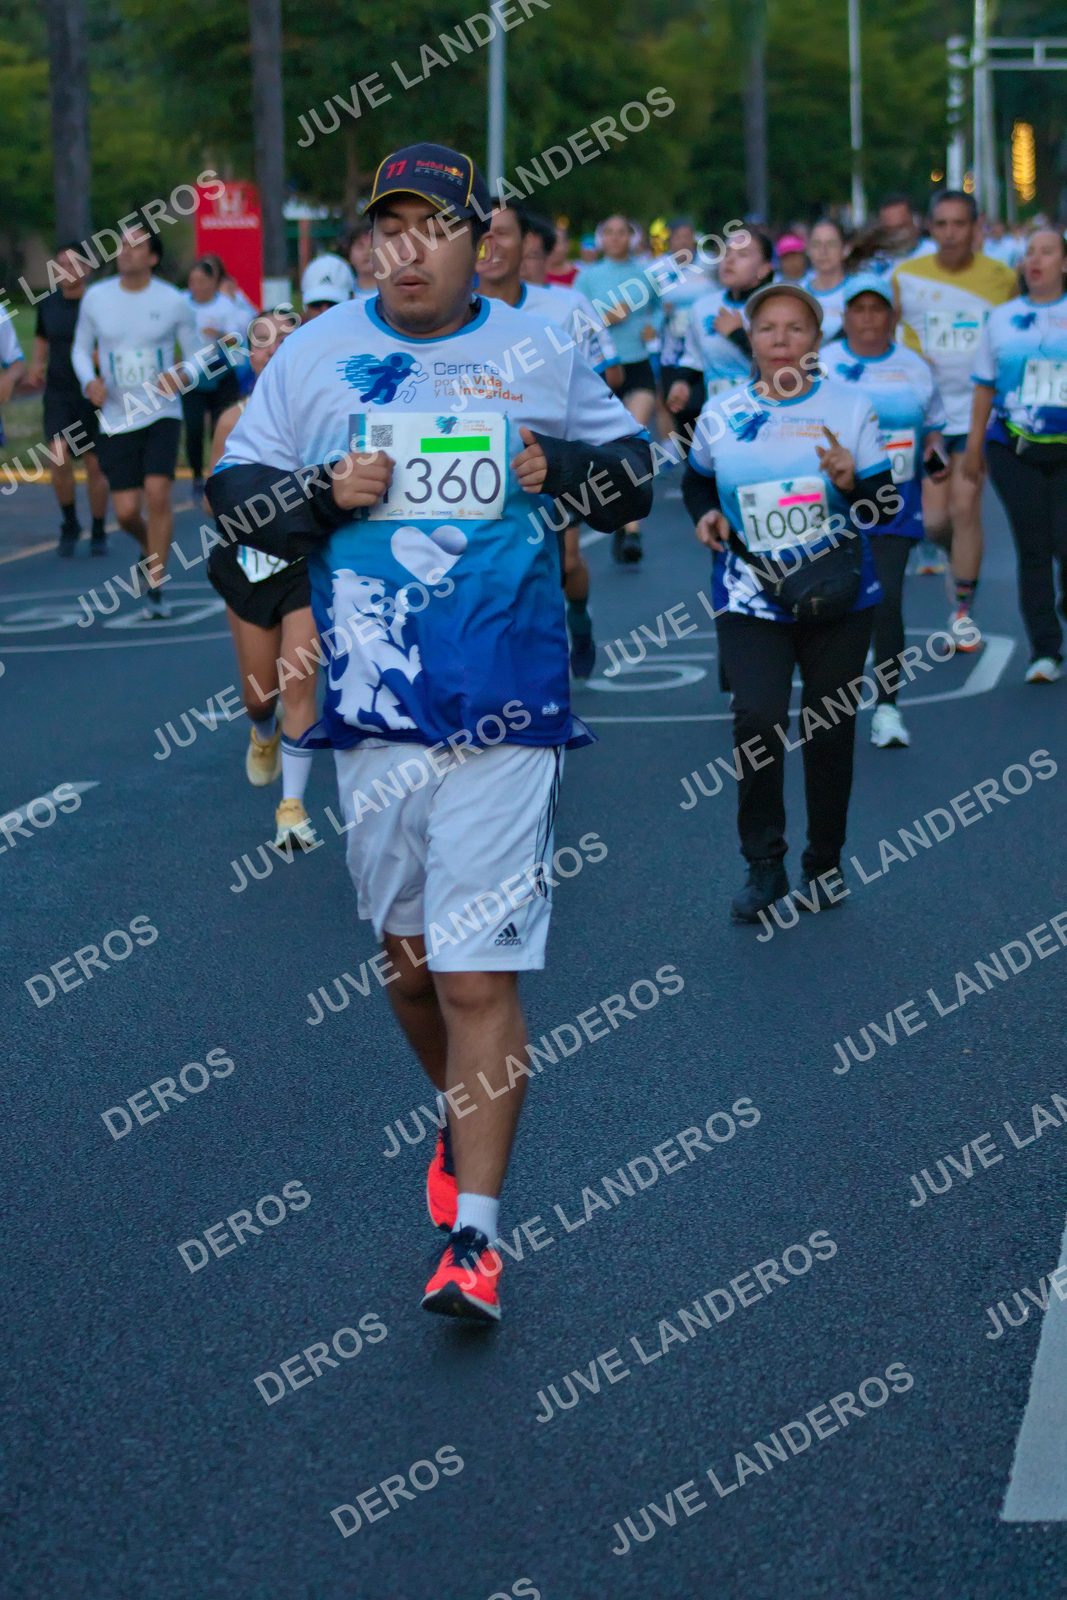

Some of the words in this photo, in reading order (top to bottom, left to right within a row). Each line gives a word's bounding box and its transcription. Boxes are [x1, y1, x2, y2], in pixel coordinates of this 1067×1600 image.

[433, 362, 500, 376] Carrera
[472, 375, 502, 388] Vida
[382, 457, 501, 504] 360
[748, 503, 826, 541] 1003
